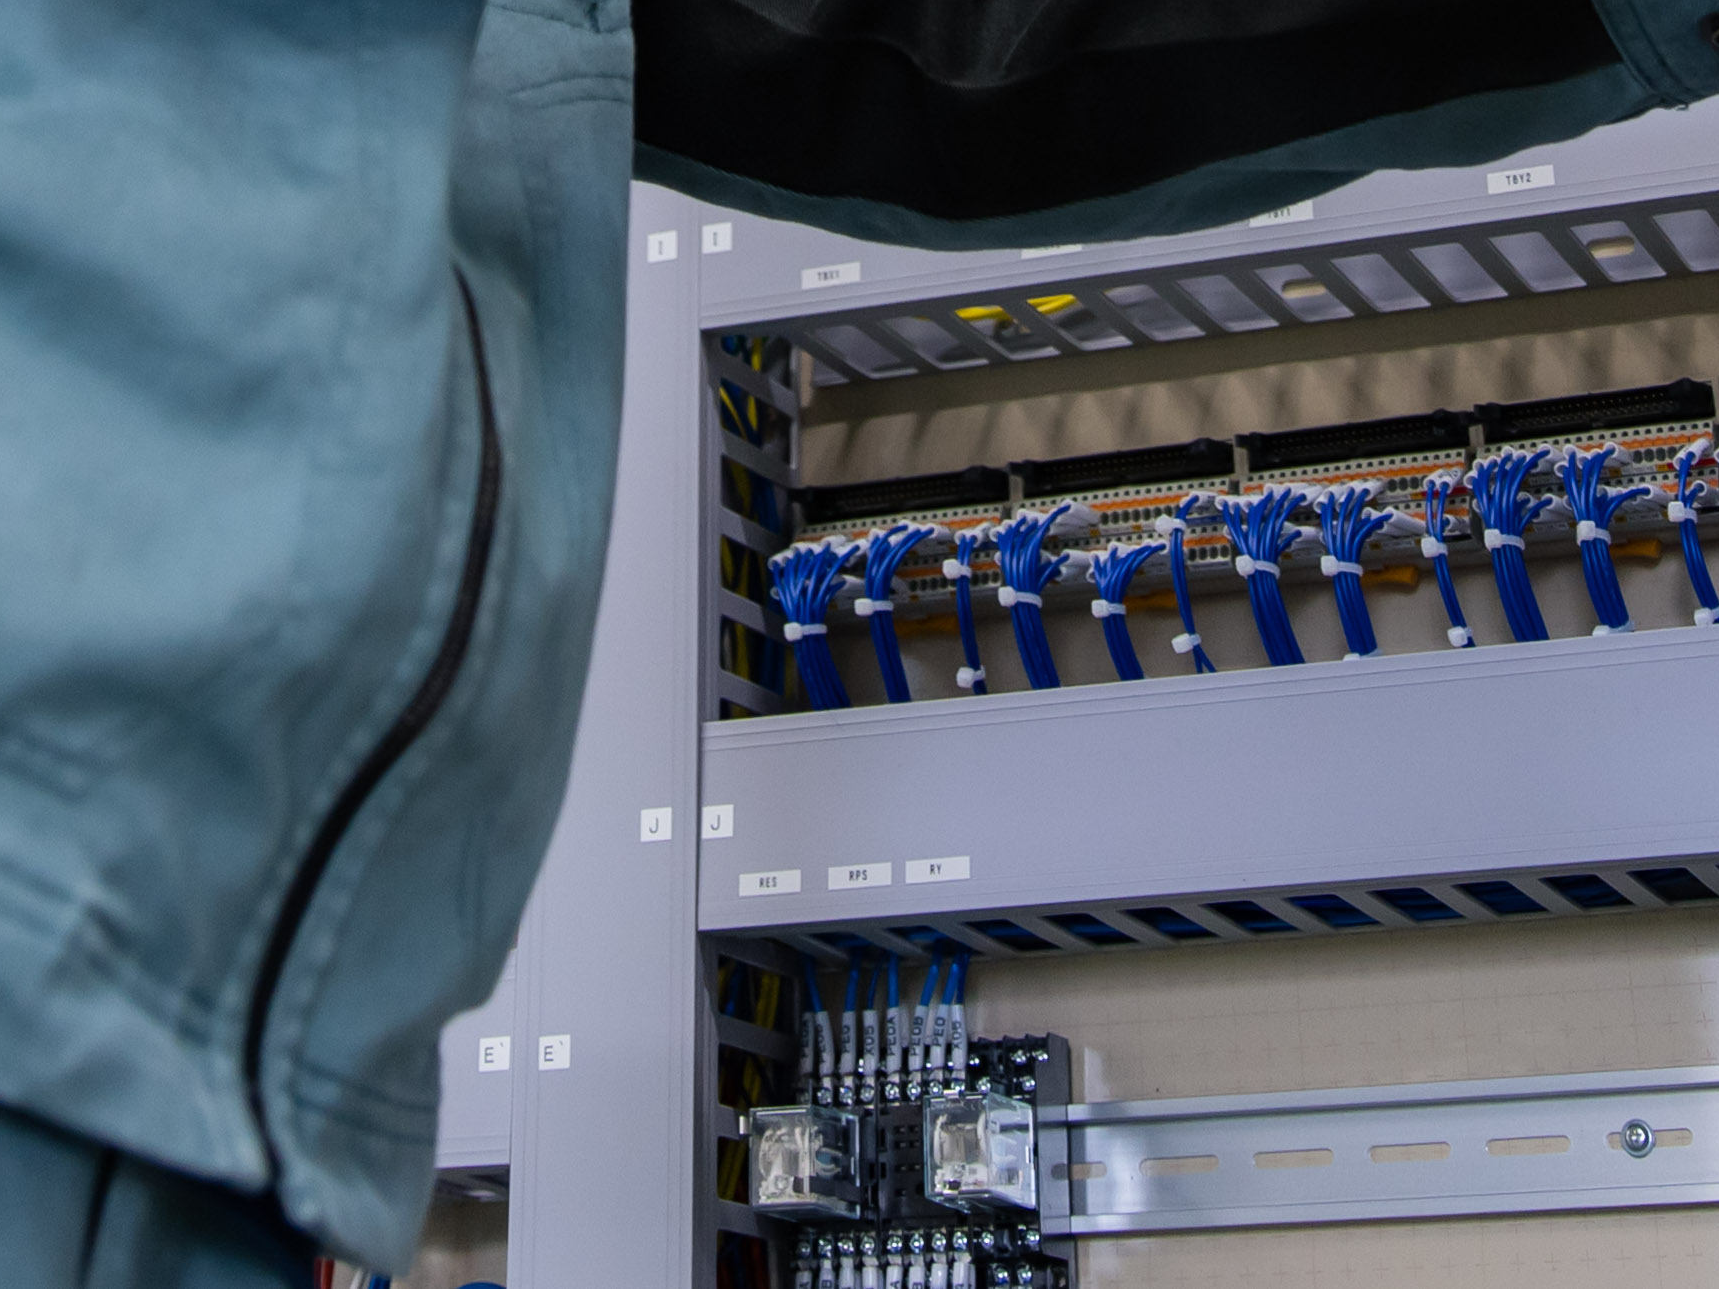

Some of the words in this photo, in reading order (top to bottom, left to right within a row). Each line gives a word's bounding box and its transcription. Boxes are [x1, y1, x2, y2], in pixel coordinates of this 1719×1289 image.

[1505, 172, 1532, 186] TBY2
[648, 817, 660, 834] J
[710, 814, 721, 831] J
[929, 863, 942, 876] RY
[758, 876, 778, 889] RES
[848, 870, 868, 883] RPS
